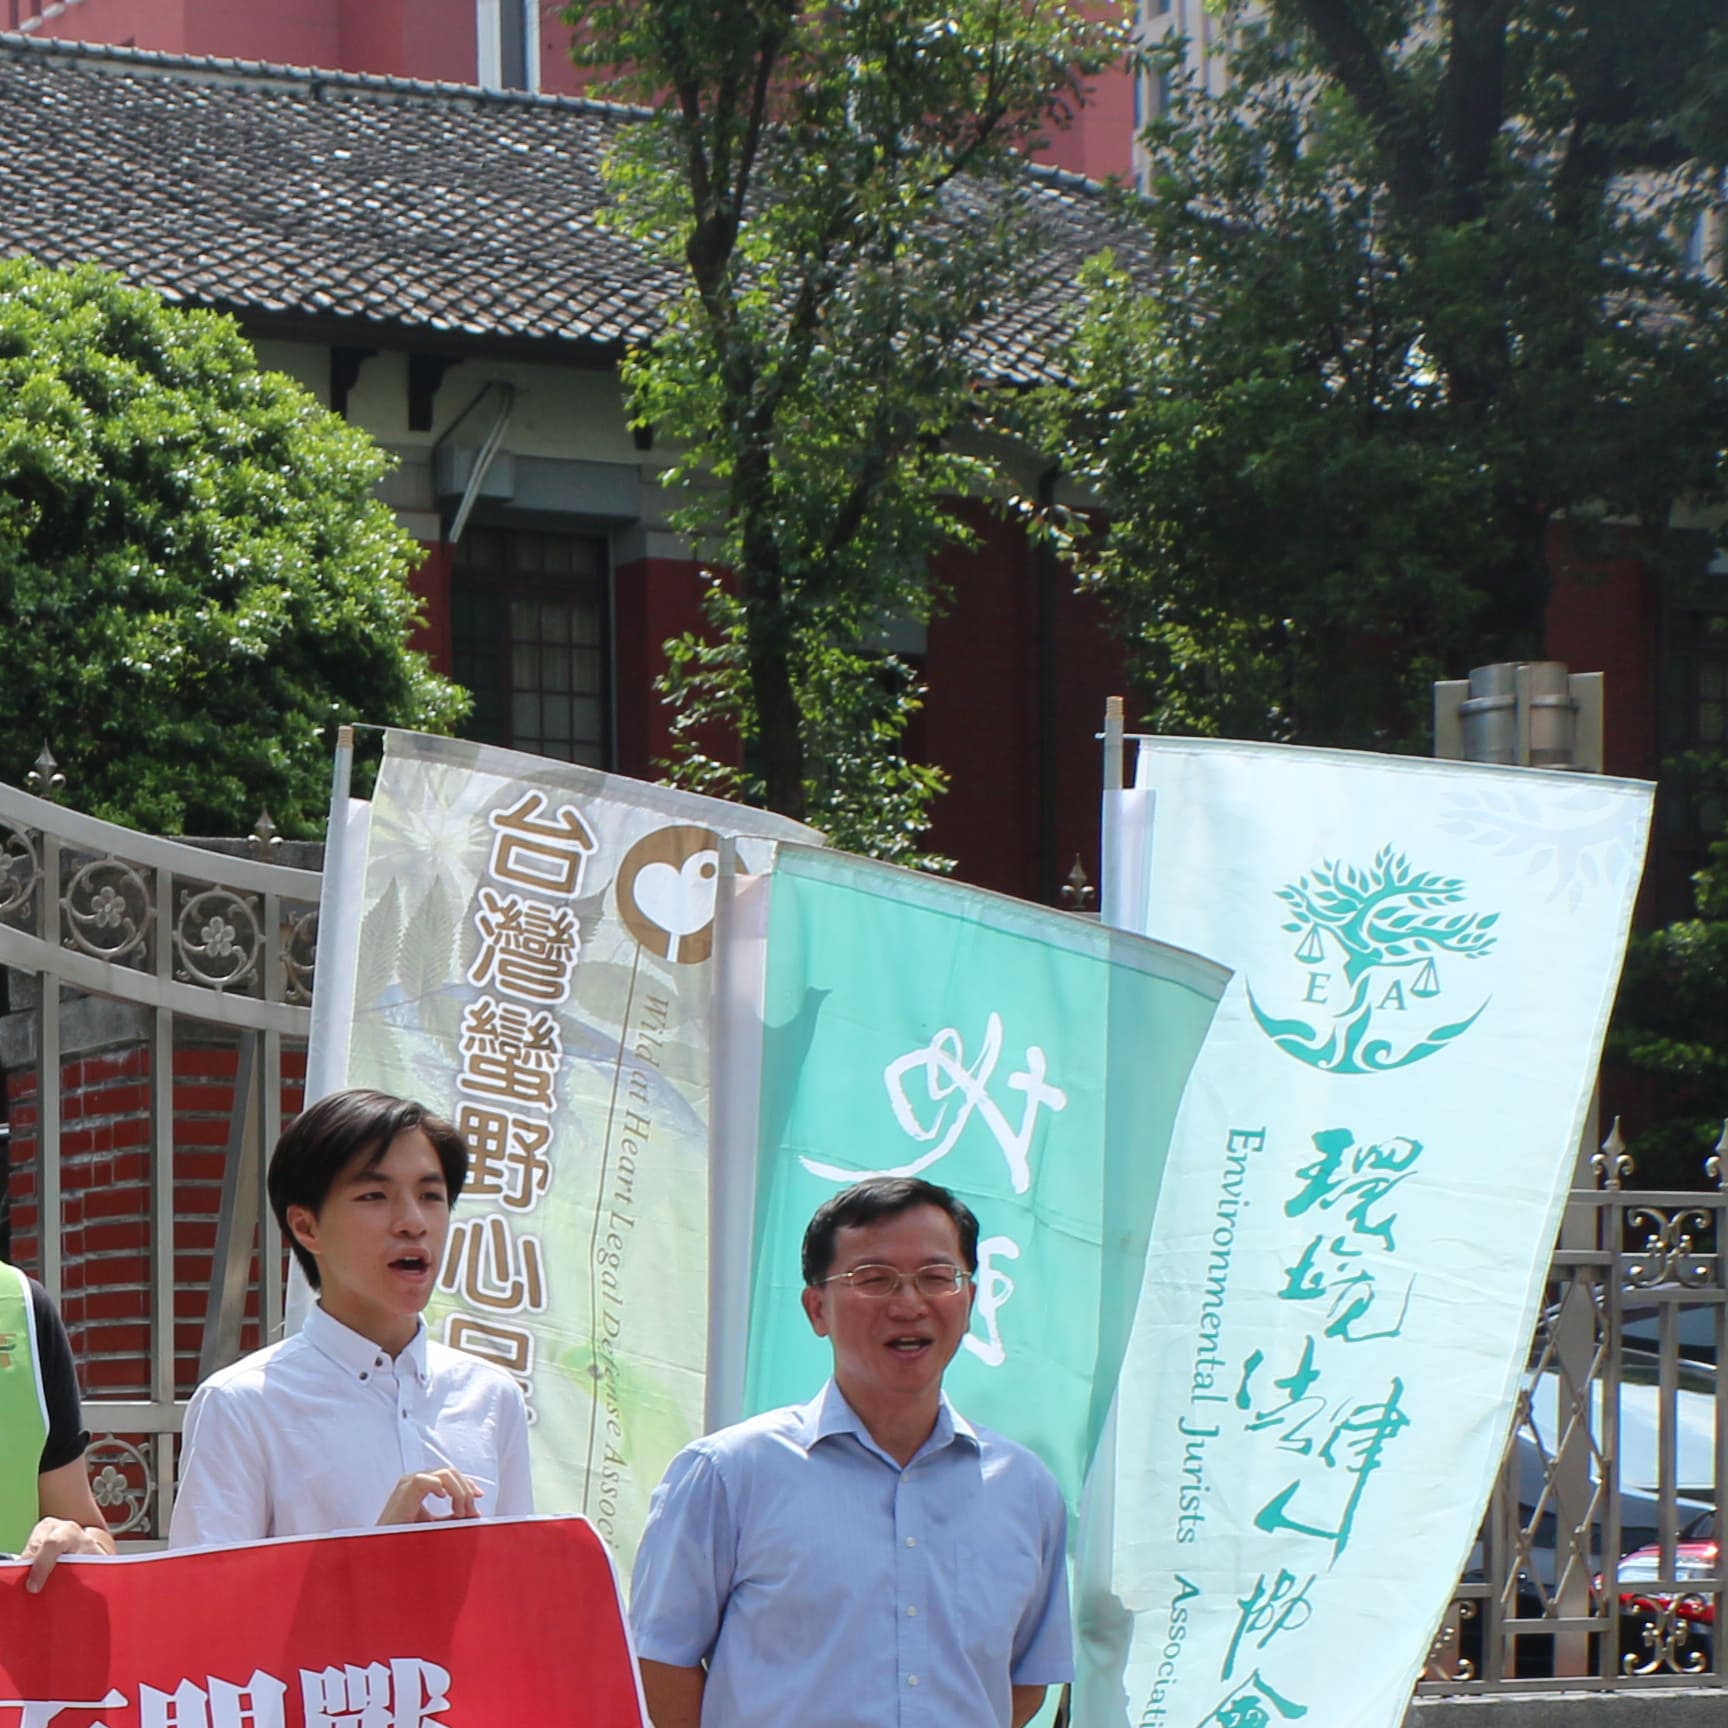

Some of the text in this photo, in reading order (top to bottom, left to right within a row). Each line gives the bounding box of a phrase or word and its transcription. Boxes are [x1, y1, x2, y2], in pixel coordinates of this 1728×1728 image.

[633, 993, 670, 1065] Wild
[629, 1070, 653, 1105] at
[613, 1111, 651, 1206] Heart
[596, 1211, 636, 1304] Legal
[1189, 1126, 1267, 1404] Environmental
[599, 1310, 626, 1437] Defense
[1175, 1417, 1220, 1544] Jurists
